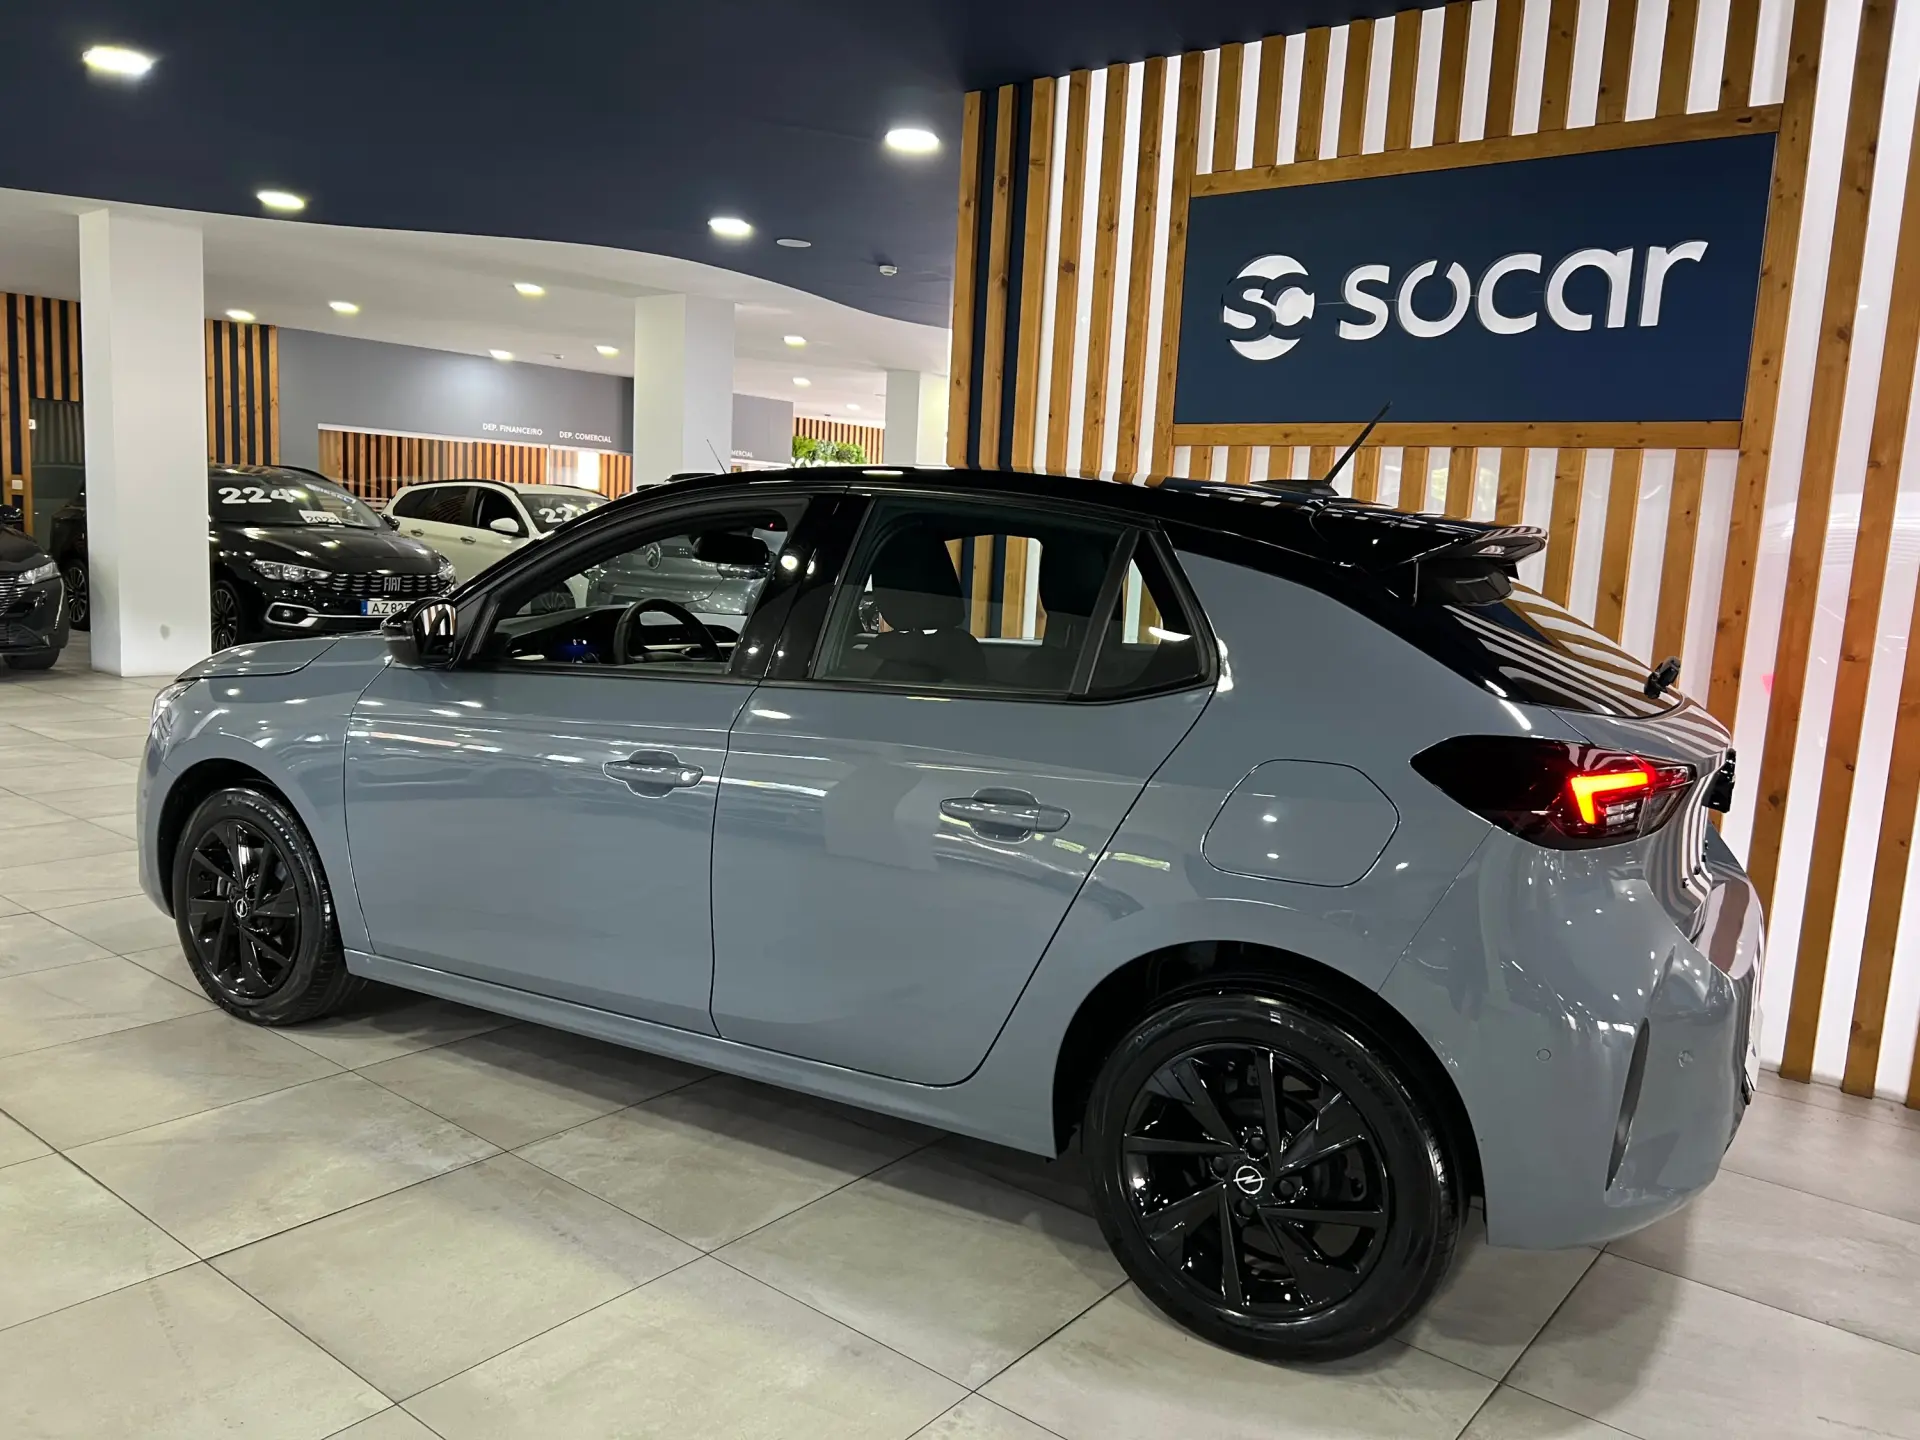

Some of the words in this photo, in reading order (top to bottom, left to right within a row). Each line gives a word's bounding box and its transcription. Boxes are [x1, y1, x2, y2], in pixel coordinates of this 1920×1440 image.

[1335, 239, 1709, 341] socar
[482, 422, 498, 432] DEP.
[499, 424, 544, 436] FINANCEIRO
[559, 430, 574, 439] DEP.
[575, 432, 612, 443] COMERCIAL
[218, 486, 294, 505] 224
[383, 576, 402, 592] FIAT
